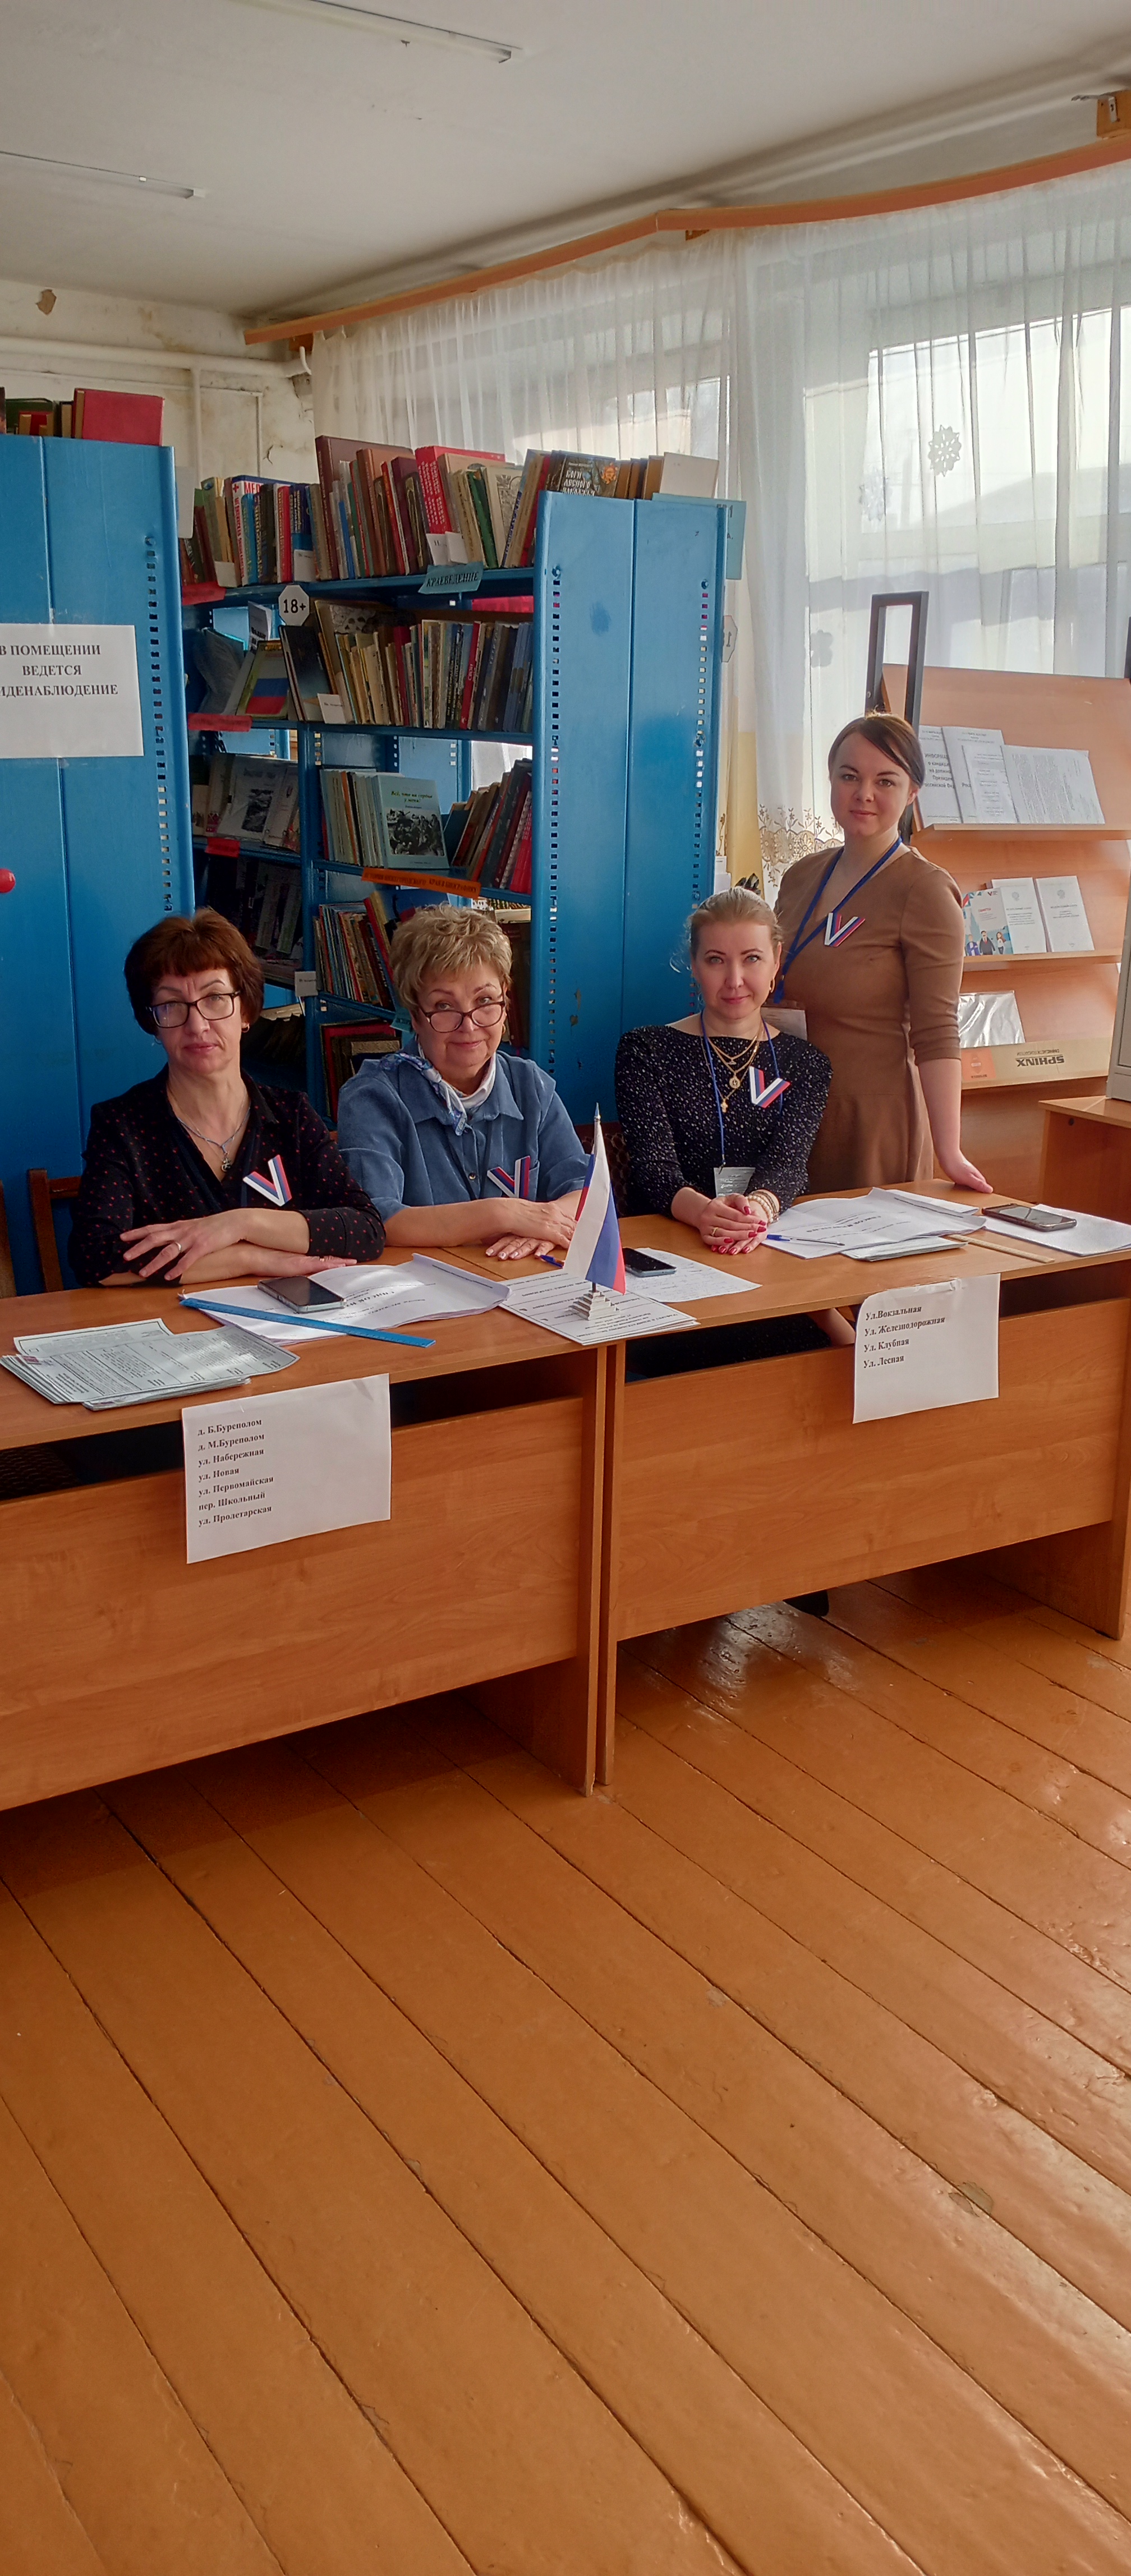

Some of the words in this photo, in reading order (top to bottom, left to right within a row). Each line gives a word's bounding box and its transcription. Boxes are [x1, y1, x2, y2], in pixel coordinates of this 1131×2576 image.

[426, 571, 479, 587] КРАЕВЕДЕНИЕ
[283, 599, 306, 613] 18+
[0, 645, 6, 655] В
[11, 645, 100, 657] ПОМЕЩЕНИИ
[22, 665, 82, 677] ВЕДЕТСЯ
[1015, 1056, 1064, 1067] SPHINX
[866, 1307, 922, 1321] Ул.Вокзальная
[878, 1317, 945, 1334] Железнодорожная
[864, 1344, 876, 1353] Ул.
[878, 1338, 909, 1350] Клубная
[877, 1355, 904, 1366] Лесная
[208, 1419, 262, 1433] Б.Буреполом
[208, 1434, 265, 1448] М.Буреполом
[199, 1459, 210, 1468] ул.
[213, 1449, 264, 1463] Набережная
[199, 1474, 210, 1483] ул.
[213, 1468, 239, 1478] Новая
[213, 1476, 274, 1493] Первомайская
[218, 1492, 265, 1507] Школьный
[213, 1506, 272, 1523] Пролетарская
